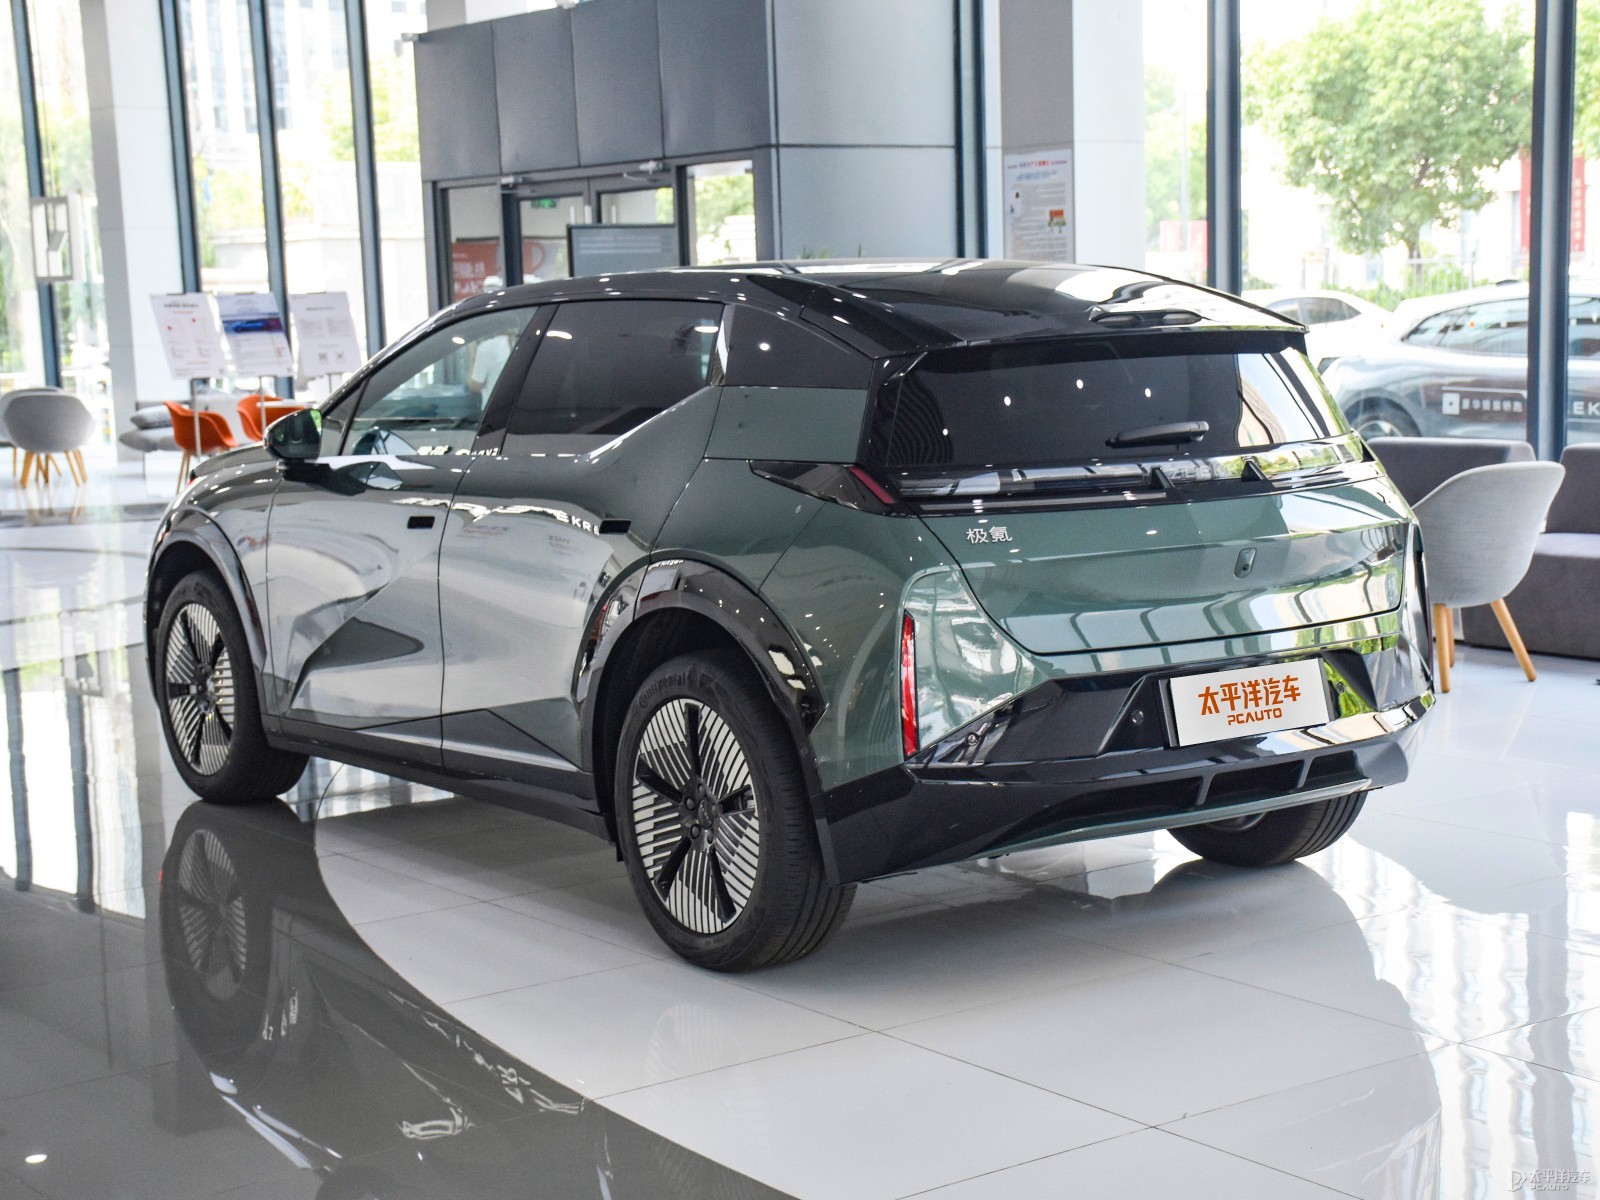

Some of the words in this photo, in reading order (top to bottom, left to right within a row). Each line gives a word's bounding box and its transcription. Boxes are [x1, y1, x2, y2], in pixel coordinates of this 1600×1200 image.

[966, 525, 1013, 544] 极氪
[1198, 674, 1302, 716] 太平洋汽车
[1227, 708, 1283, 725] PCAUTO
